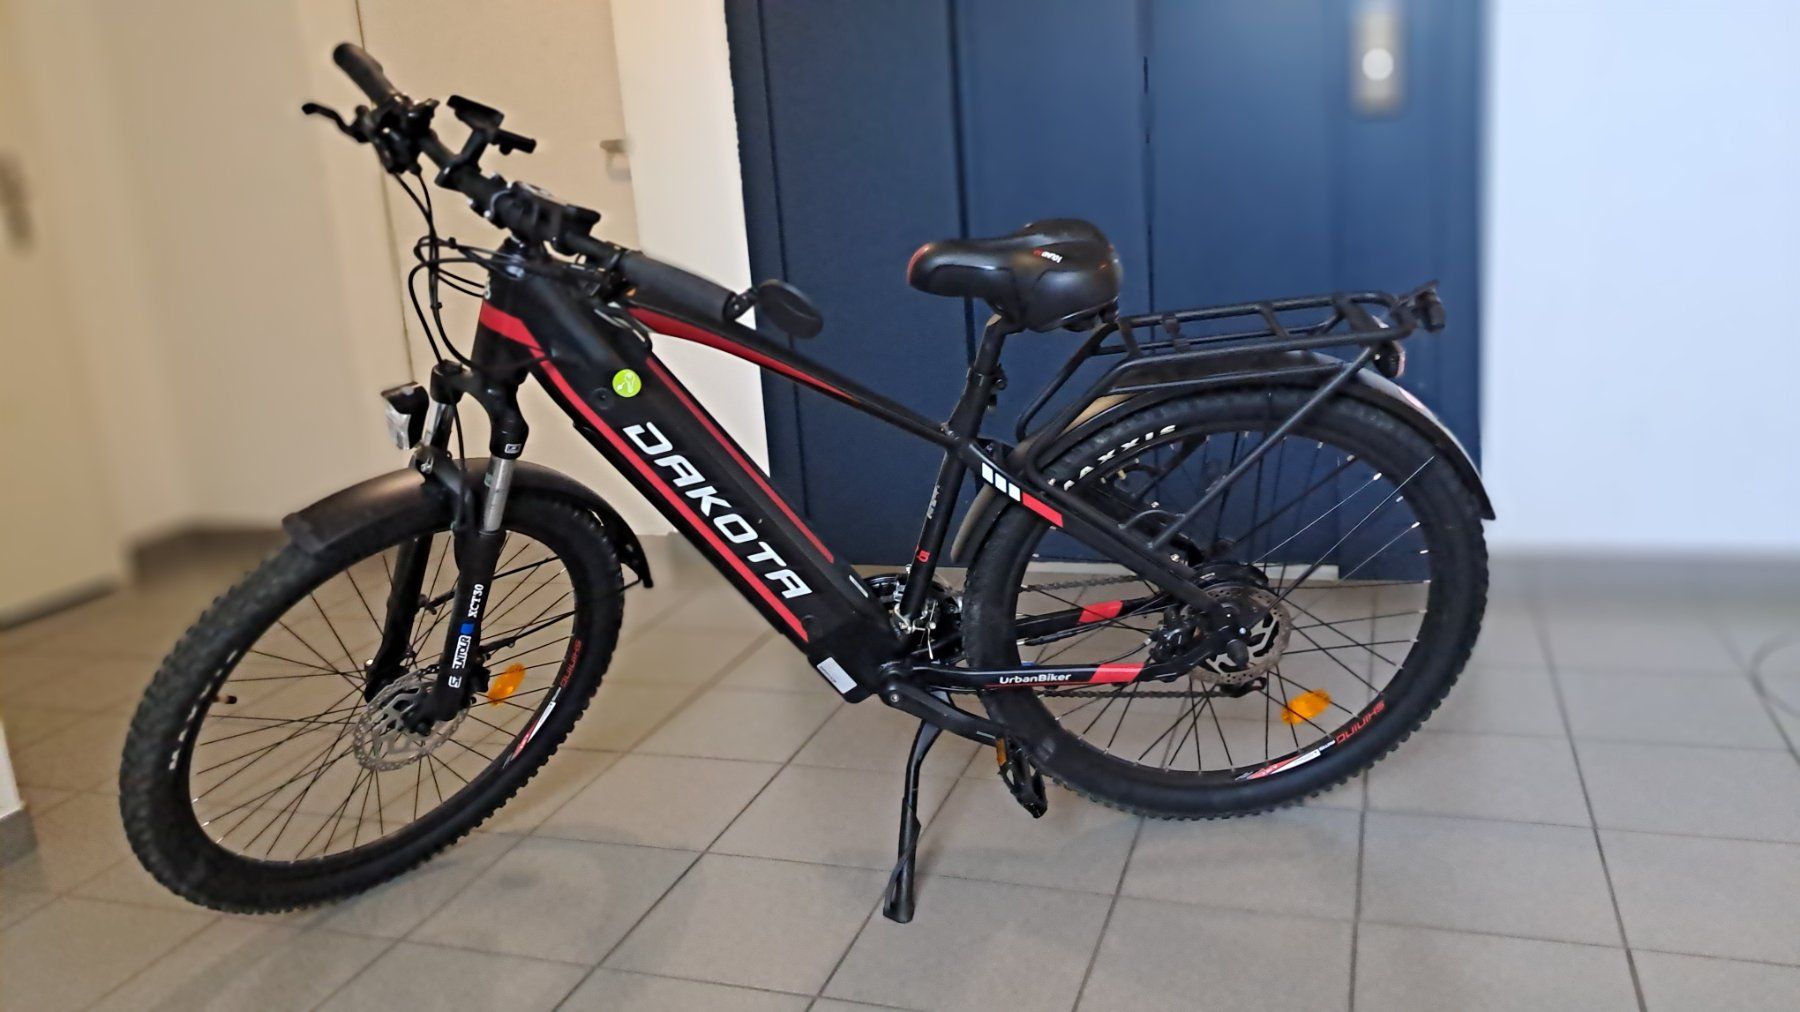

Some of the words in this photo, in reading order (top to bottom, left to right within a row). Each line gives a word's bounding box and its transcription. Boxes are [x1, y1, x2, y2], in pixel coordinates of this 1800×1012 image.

[622, 421, 813, 599] DAKOTA
[468, 583, 484, 618] XCT30
[999, 673, 1072, 685] UrbanBiker
